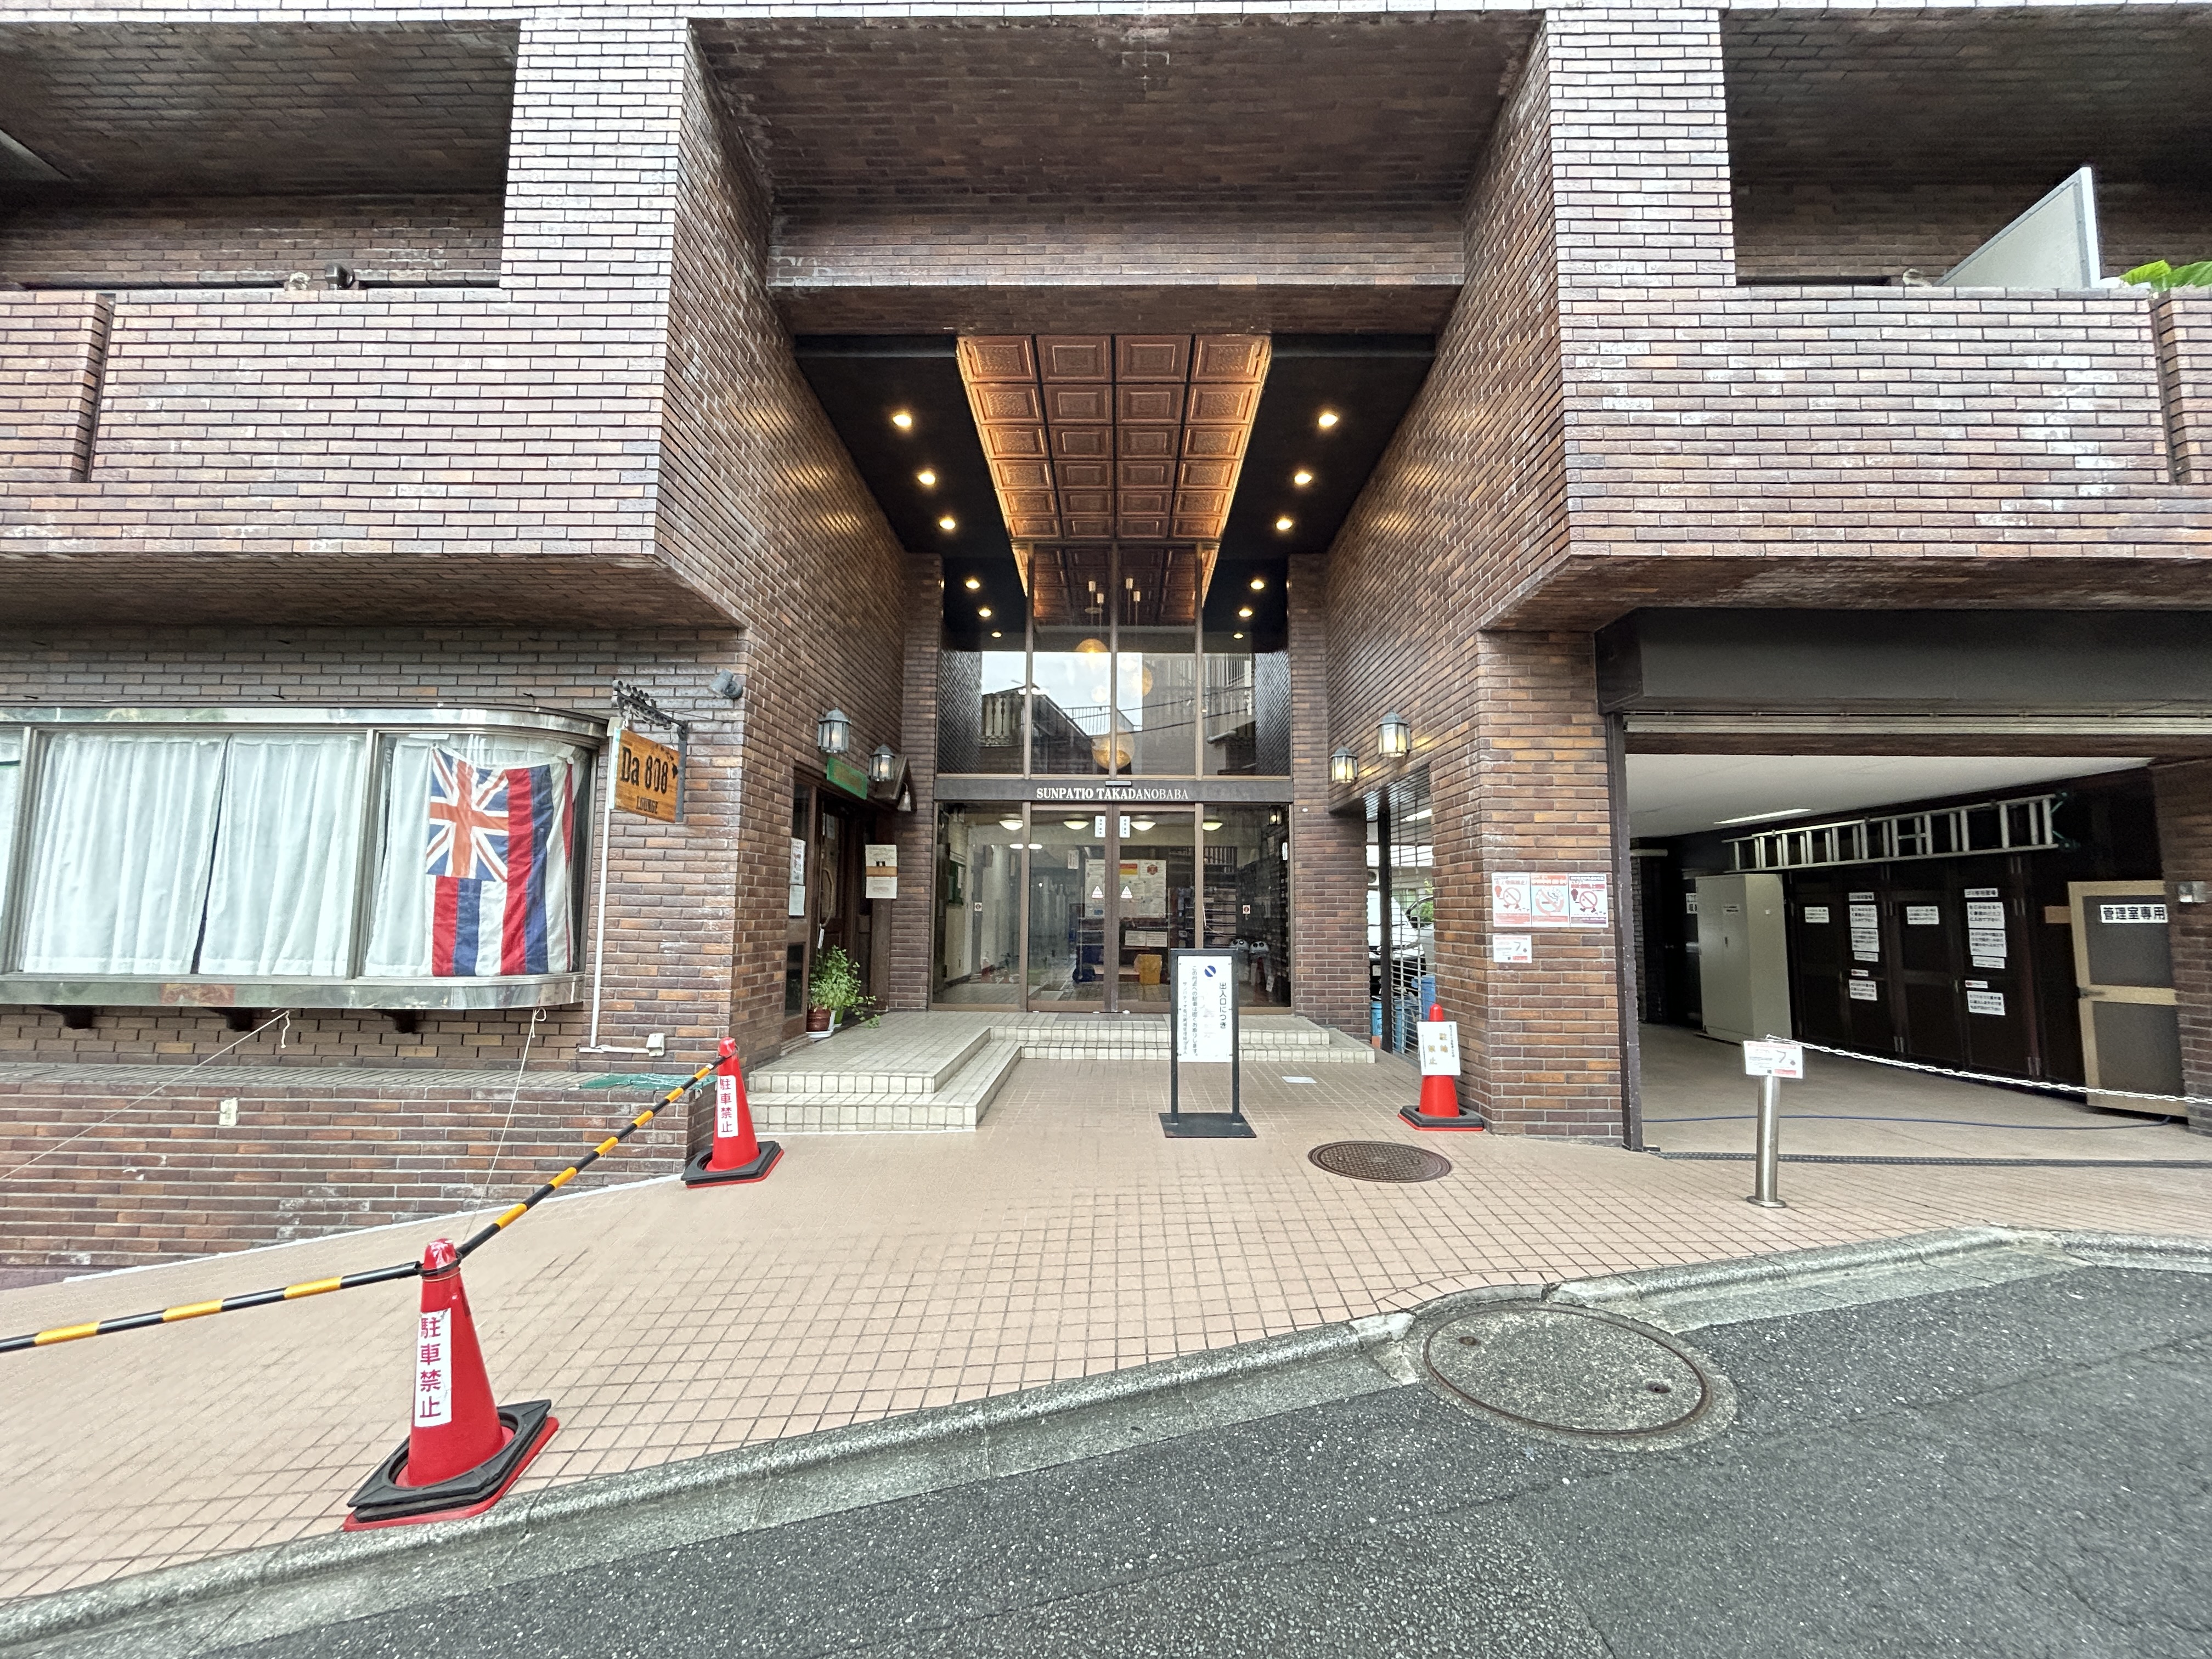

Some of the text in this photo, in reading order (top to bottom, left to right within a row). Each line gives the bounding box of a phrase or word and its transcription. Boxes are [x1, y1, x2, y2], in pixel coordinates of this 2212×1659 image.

[620, 747, 668, 794] Da 808
[636, 796, 658, 814] LOUNGE
[1036, 788, 1189, 800] SUNPATIO TAKADANOBABA
[2103, 906, 2165, 920] 管理室専用
[720, 1077, 733, 1133] 駐車禁止
[420, 1317, 441, 1419] 駐車禁止
